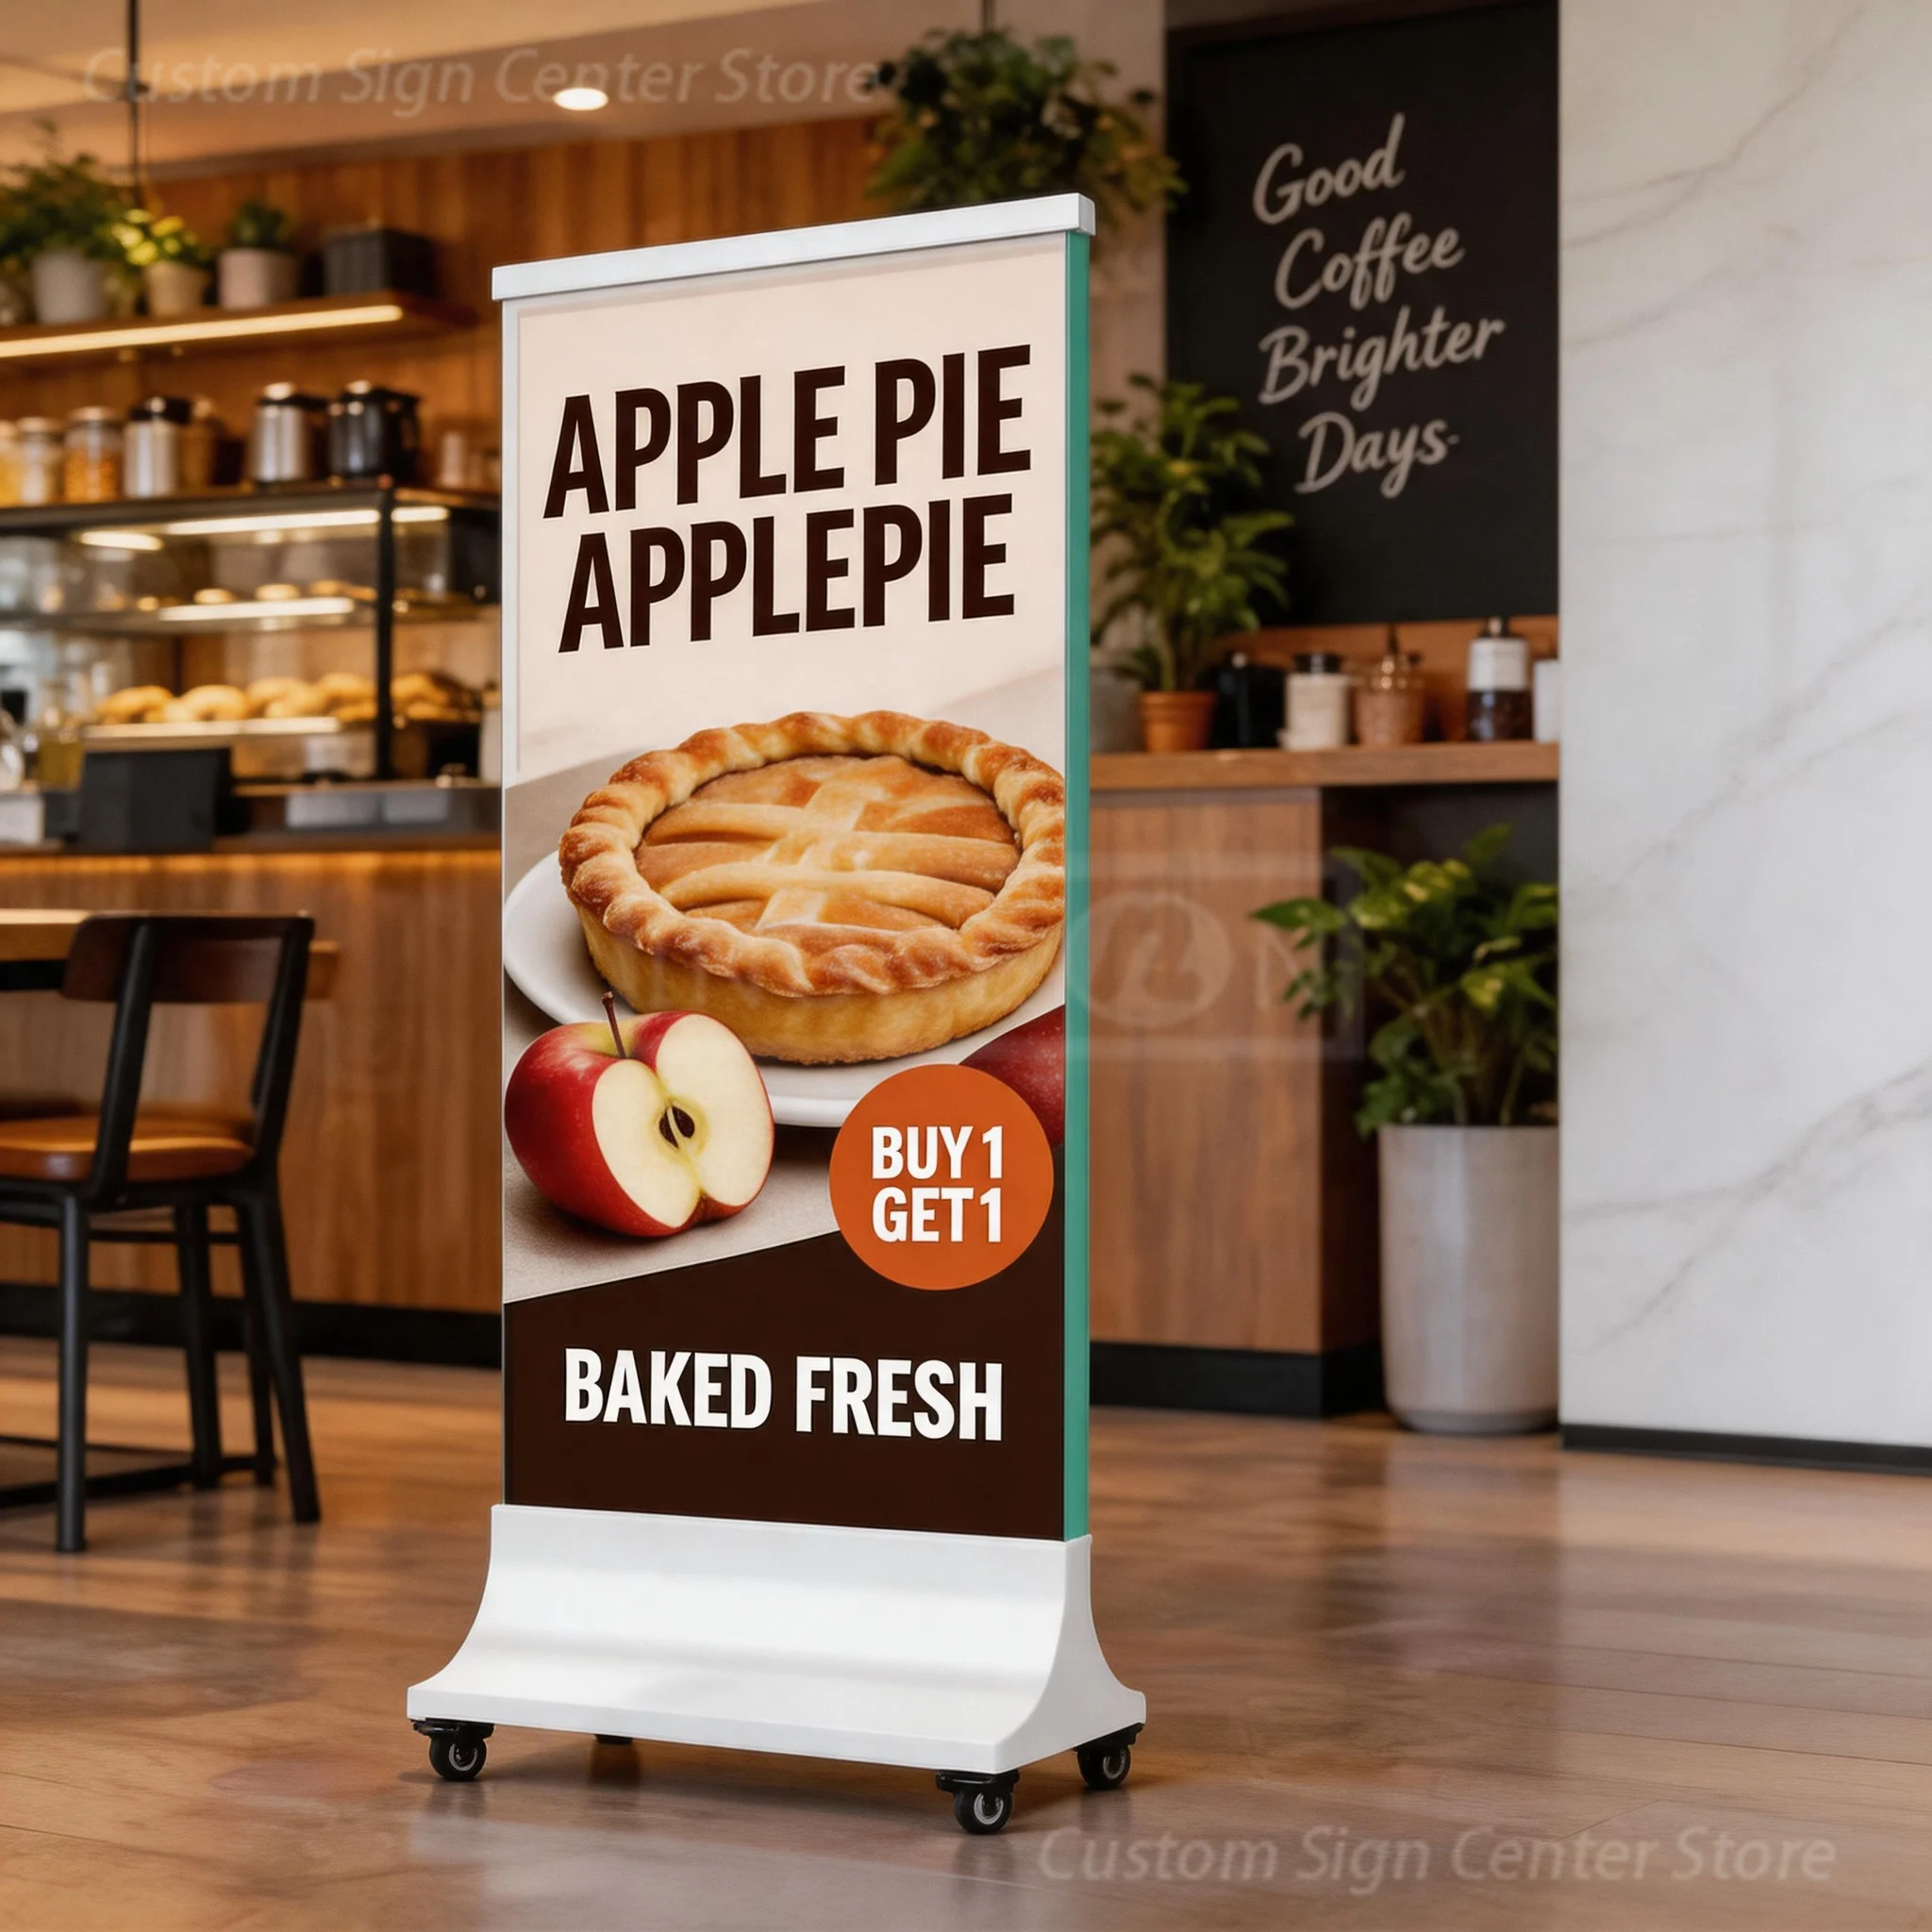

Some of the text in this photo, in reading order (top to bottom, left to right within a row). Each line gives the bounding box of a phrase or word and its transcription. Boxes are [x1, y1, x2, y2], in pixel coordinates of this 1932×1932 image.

[1253, 112, 1405, 225] Good
[1274, 211, 1464, 310] Coffee
[1257, 305, 1505, 411] Brighter
[542, 343, 1031, 519] APPLE PIE
[558, 493, 1015, 653] APPLEPIE
[872, 1125, 1003, 1180] BUY 1
[564, 1347, 1003, 1441] BAKED FRESH
